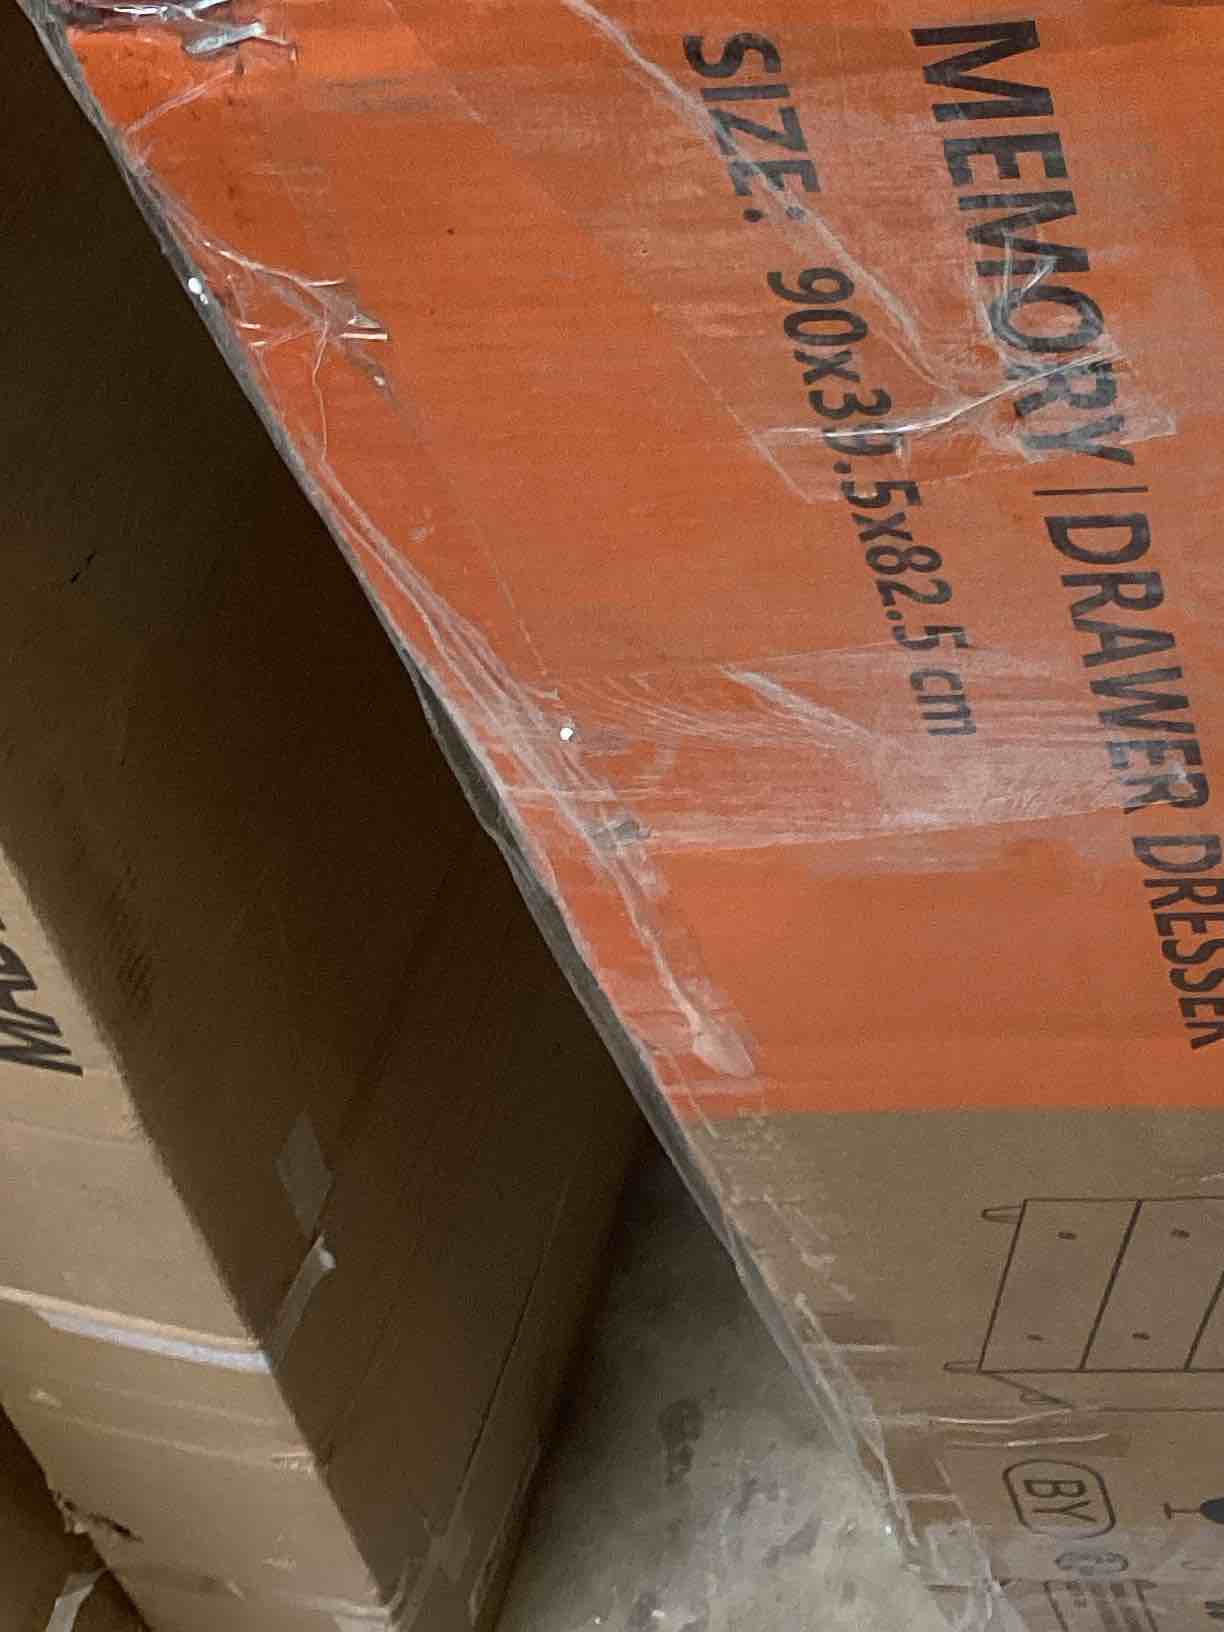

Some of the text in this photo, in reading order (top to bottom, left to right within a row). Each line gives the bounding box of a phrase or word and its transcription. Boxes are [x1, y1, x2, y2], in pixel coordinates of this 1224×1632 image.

[910, 19, 1137, 468] MEMORY
[1043, 511, 1210, 816] DRAWER
[909, 668, 978, 739] cm
[1022, 1477, 1098, 1525] BY
